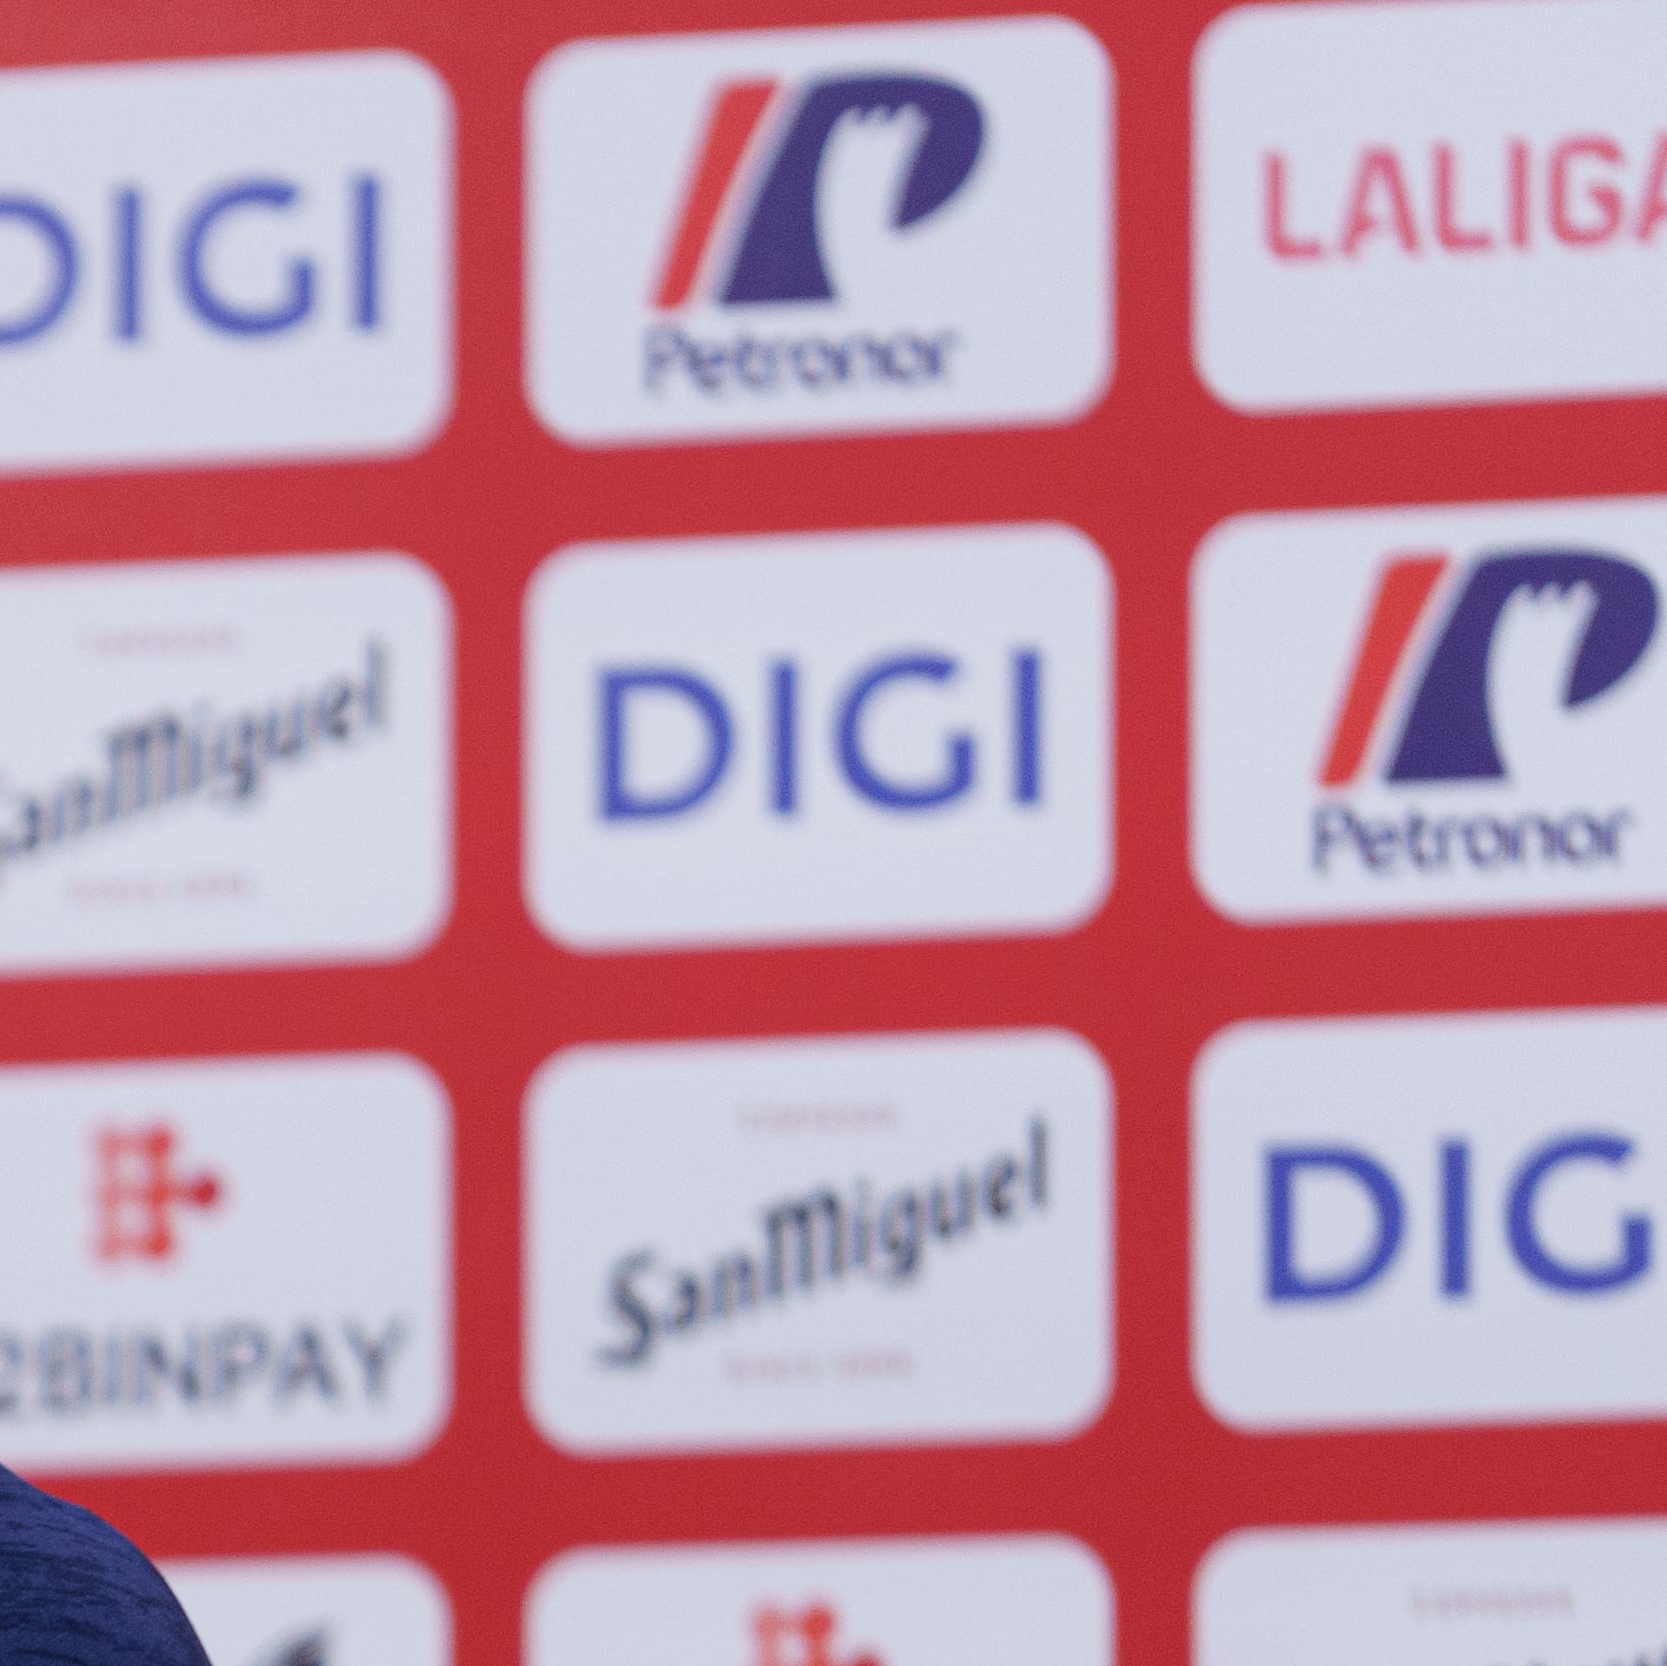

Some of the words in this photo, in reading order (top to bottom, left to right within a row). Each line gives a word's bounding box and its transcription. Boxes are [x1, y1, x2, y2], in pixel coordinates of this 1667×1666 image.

[645, 328, 955, 394] Petronor
[597, 647, 1044, 825] DIGI
[1310, 803, 1627, 876] Petronor
[1261, 1131, 1657, 1307] DIG
